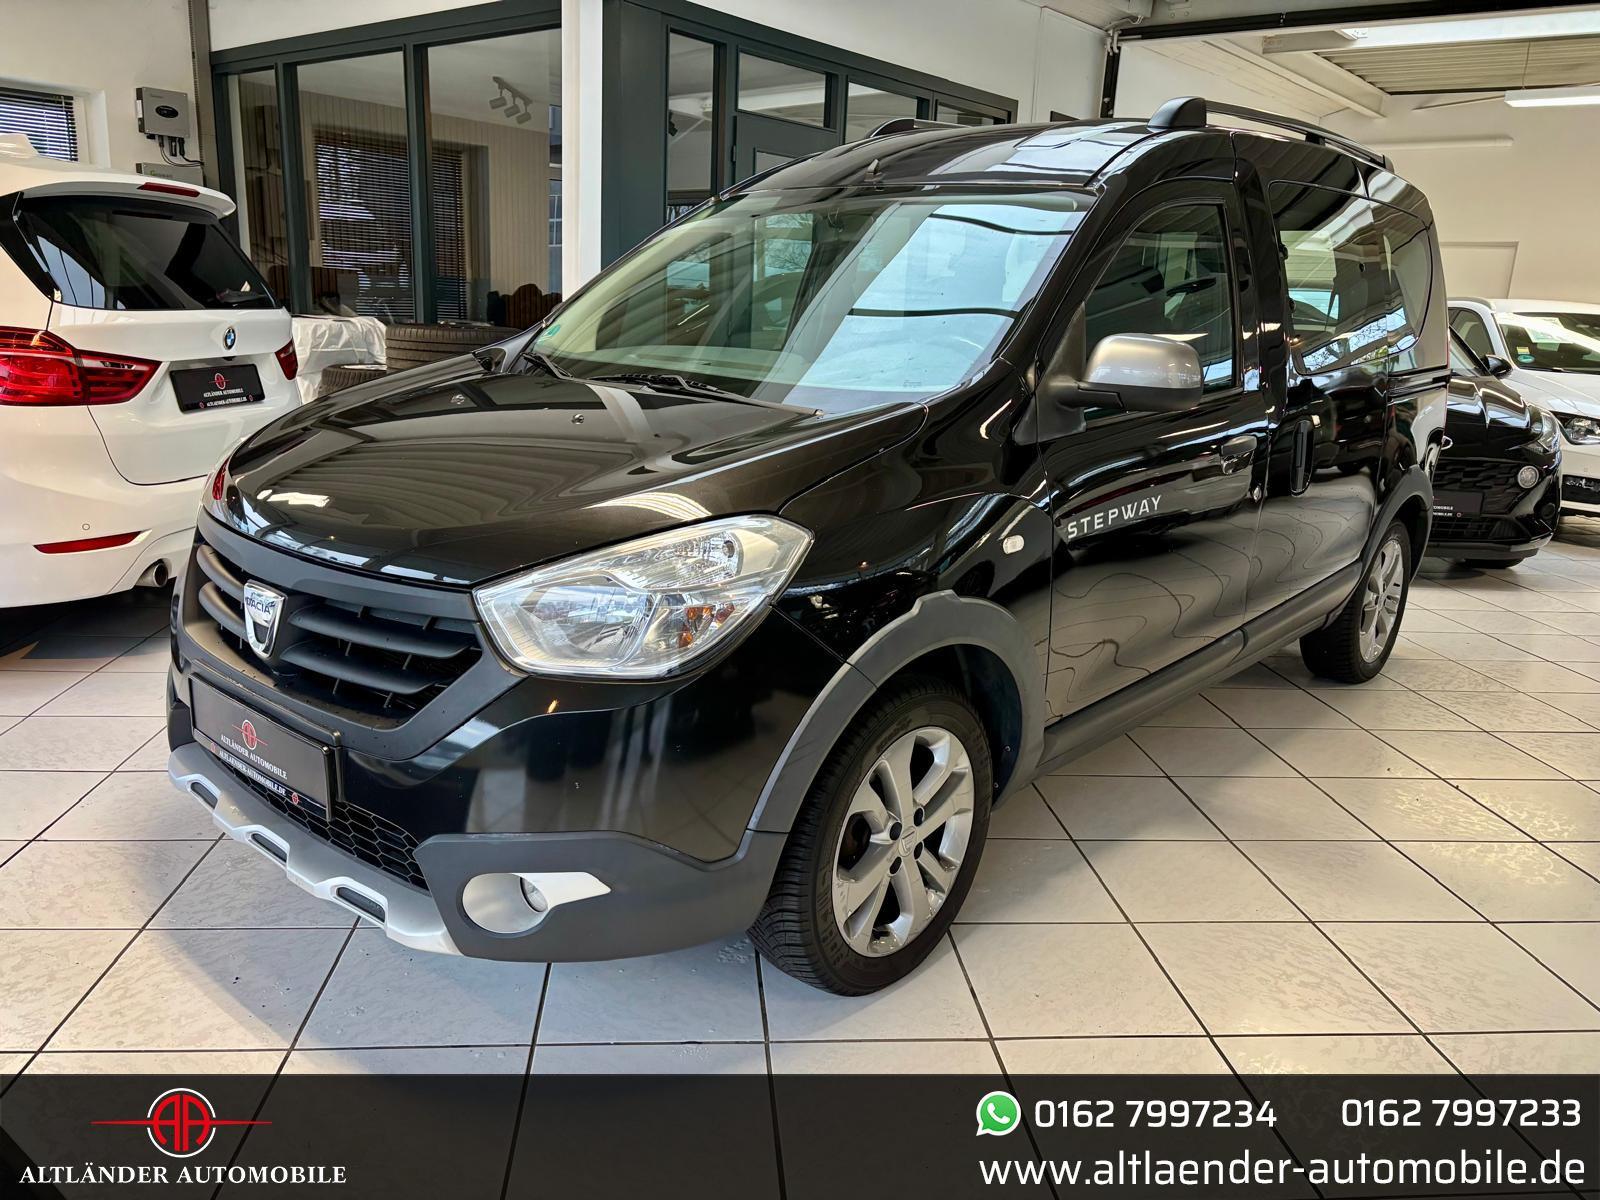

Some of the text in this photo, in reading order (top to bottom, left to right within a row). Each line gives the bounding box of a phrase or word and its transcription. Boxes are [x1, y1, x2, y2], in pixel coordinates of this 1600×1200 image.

[1067, 494, 1162, 539] STEPWAY
[245, 596, 271, 615] DACIA
[220, 733, 288, 780] ALTLÄNDER AUTOMOBILE
